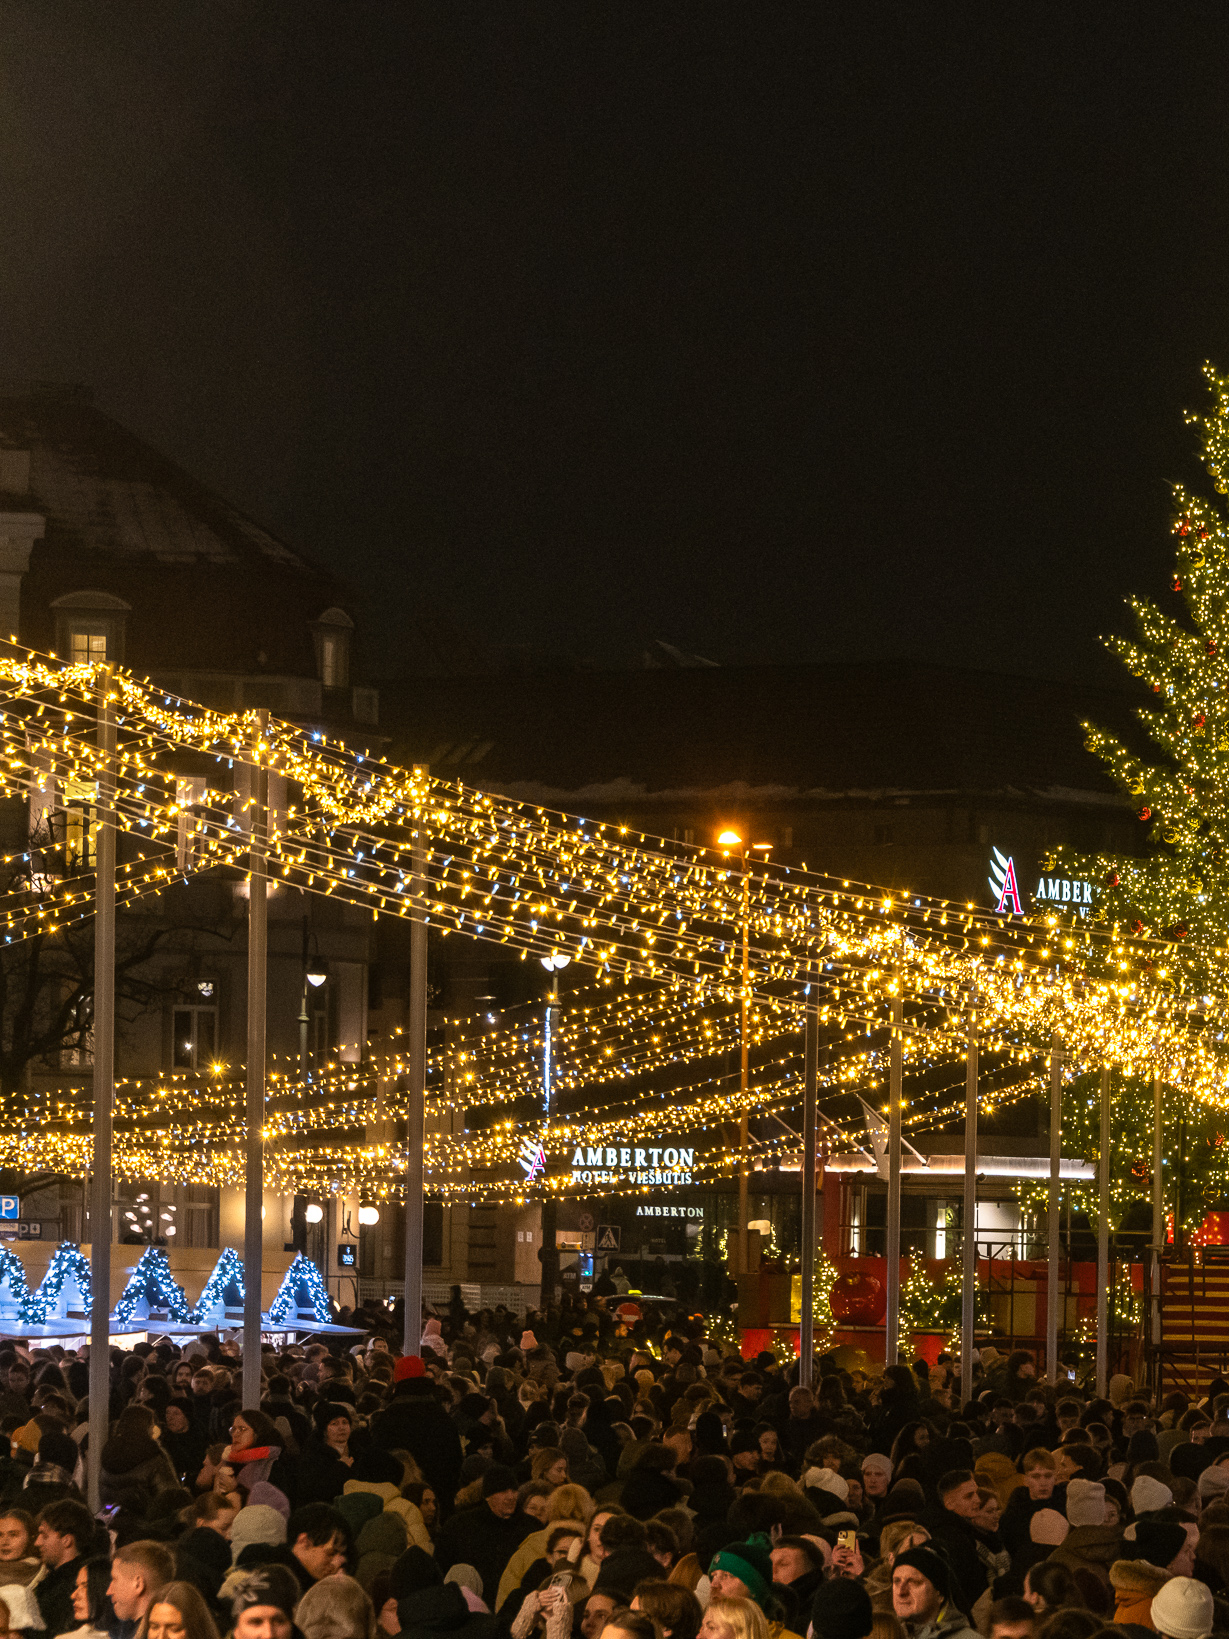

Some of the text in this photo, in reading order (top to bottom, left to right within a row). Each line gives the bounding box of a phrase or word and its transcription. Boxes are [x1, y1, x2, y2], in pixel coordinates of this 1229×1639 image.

[571, 1147, 695, 1167] AMBERTON
[571, 1170, 616, 1184] HOTEL
[628, 1168, 693, 1185] VIEŠBUTIS
[1, 1198, 16, 1217] P
[636, 1206, 704, 1217] AMBERTON
